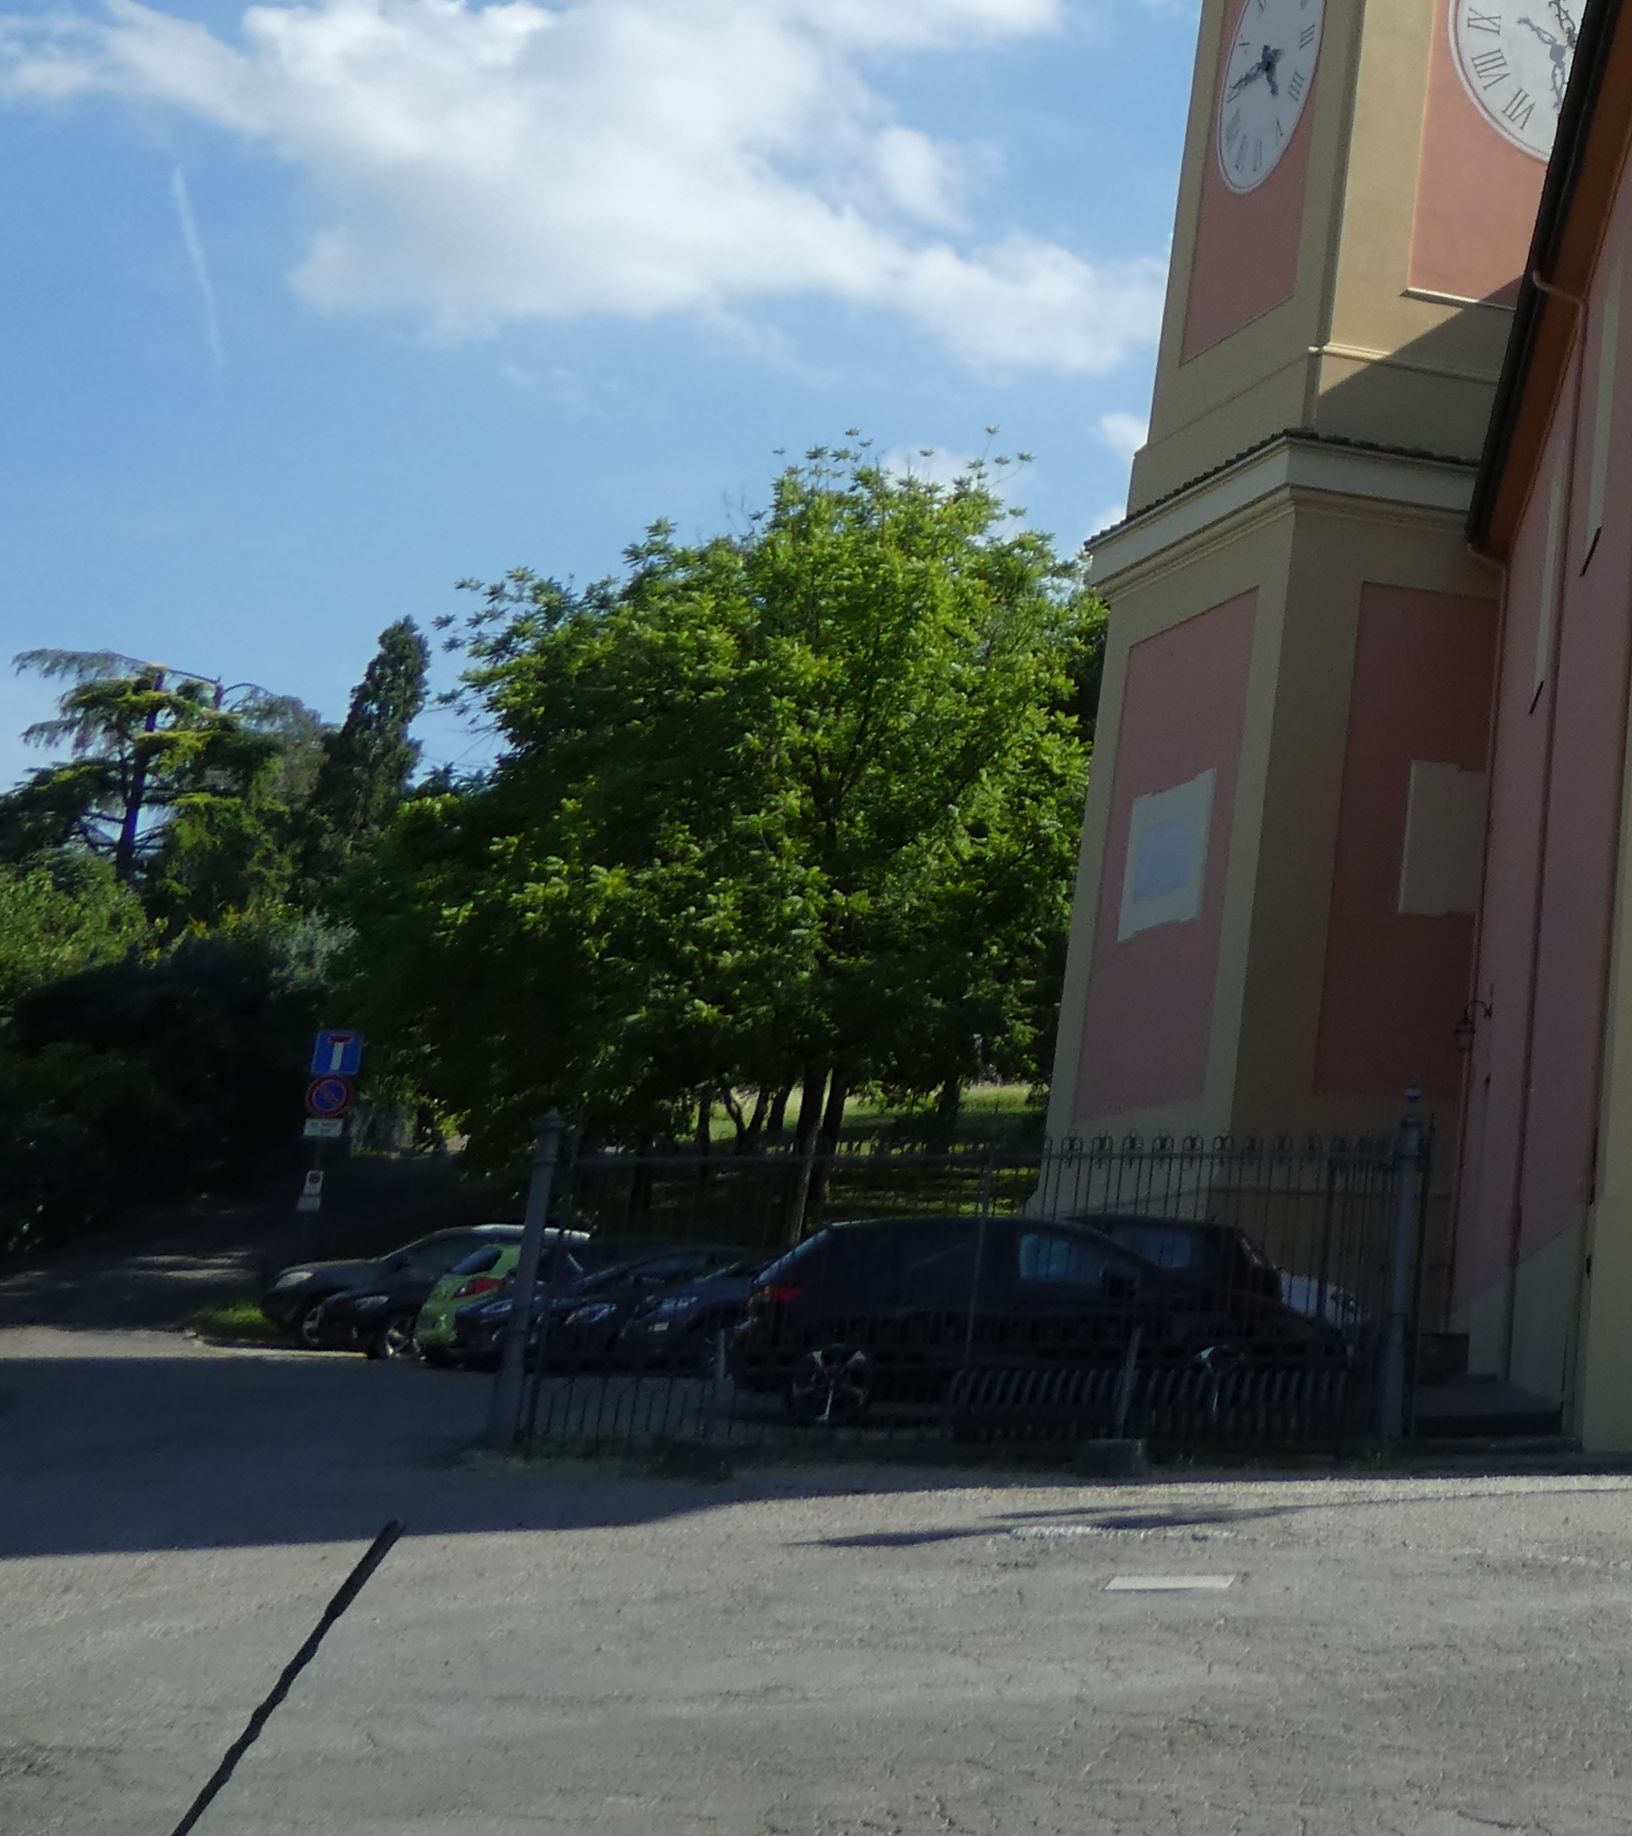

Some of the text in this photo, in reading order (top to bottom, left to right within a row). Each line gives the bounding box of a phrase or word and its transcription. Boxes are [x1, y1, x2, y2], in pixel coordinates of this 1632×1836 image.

[1467, 7, 1502, 36] IX
[1471, 49, 1511, 91] VIII
[1501, 88, 1537, 130] VII
